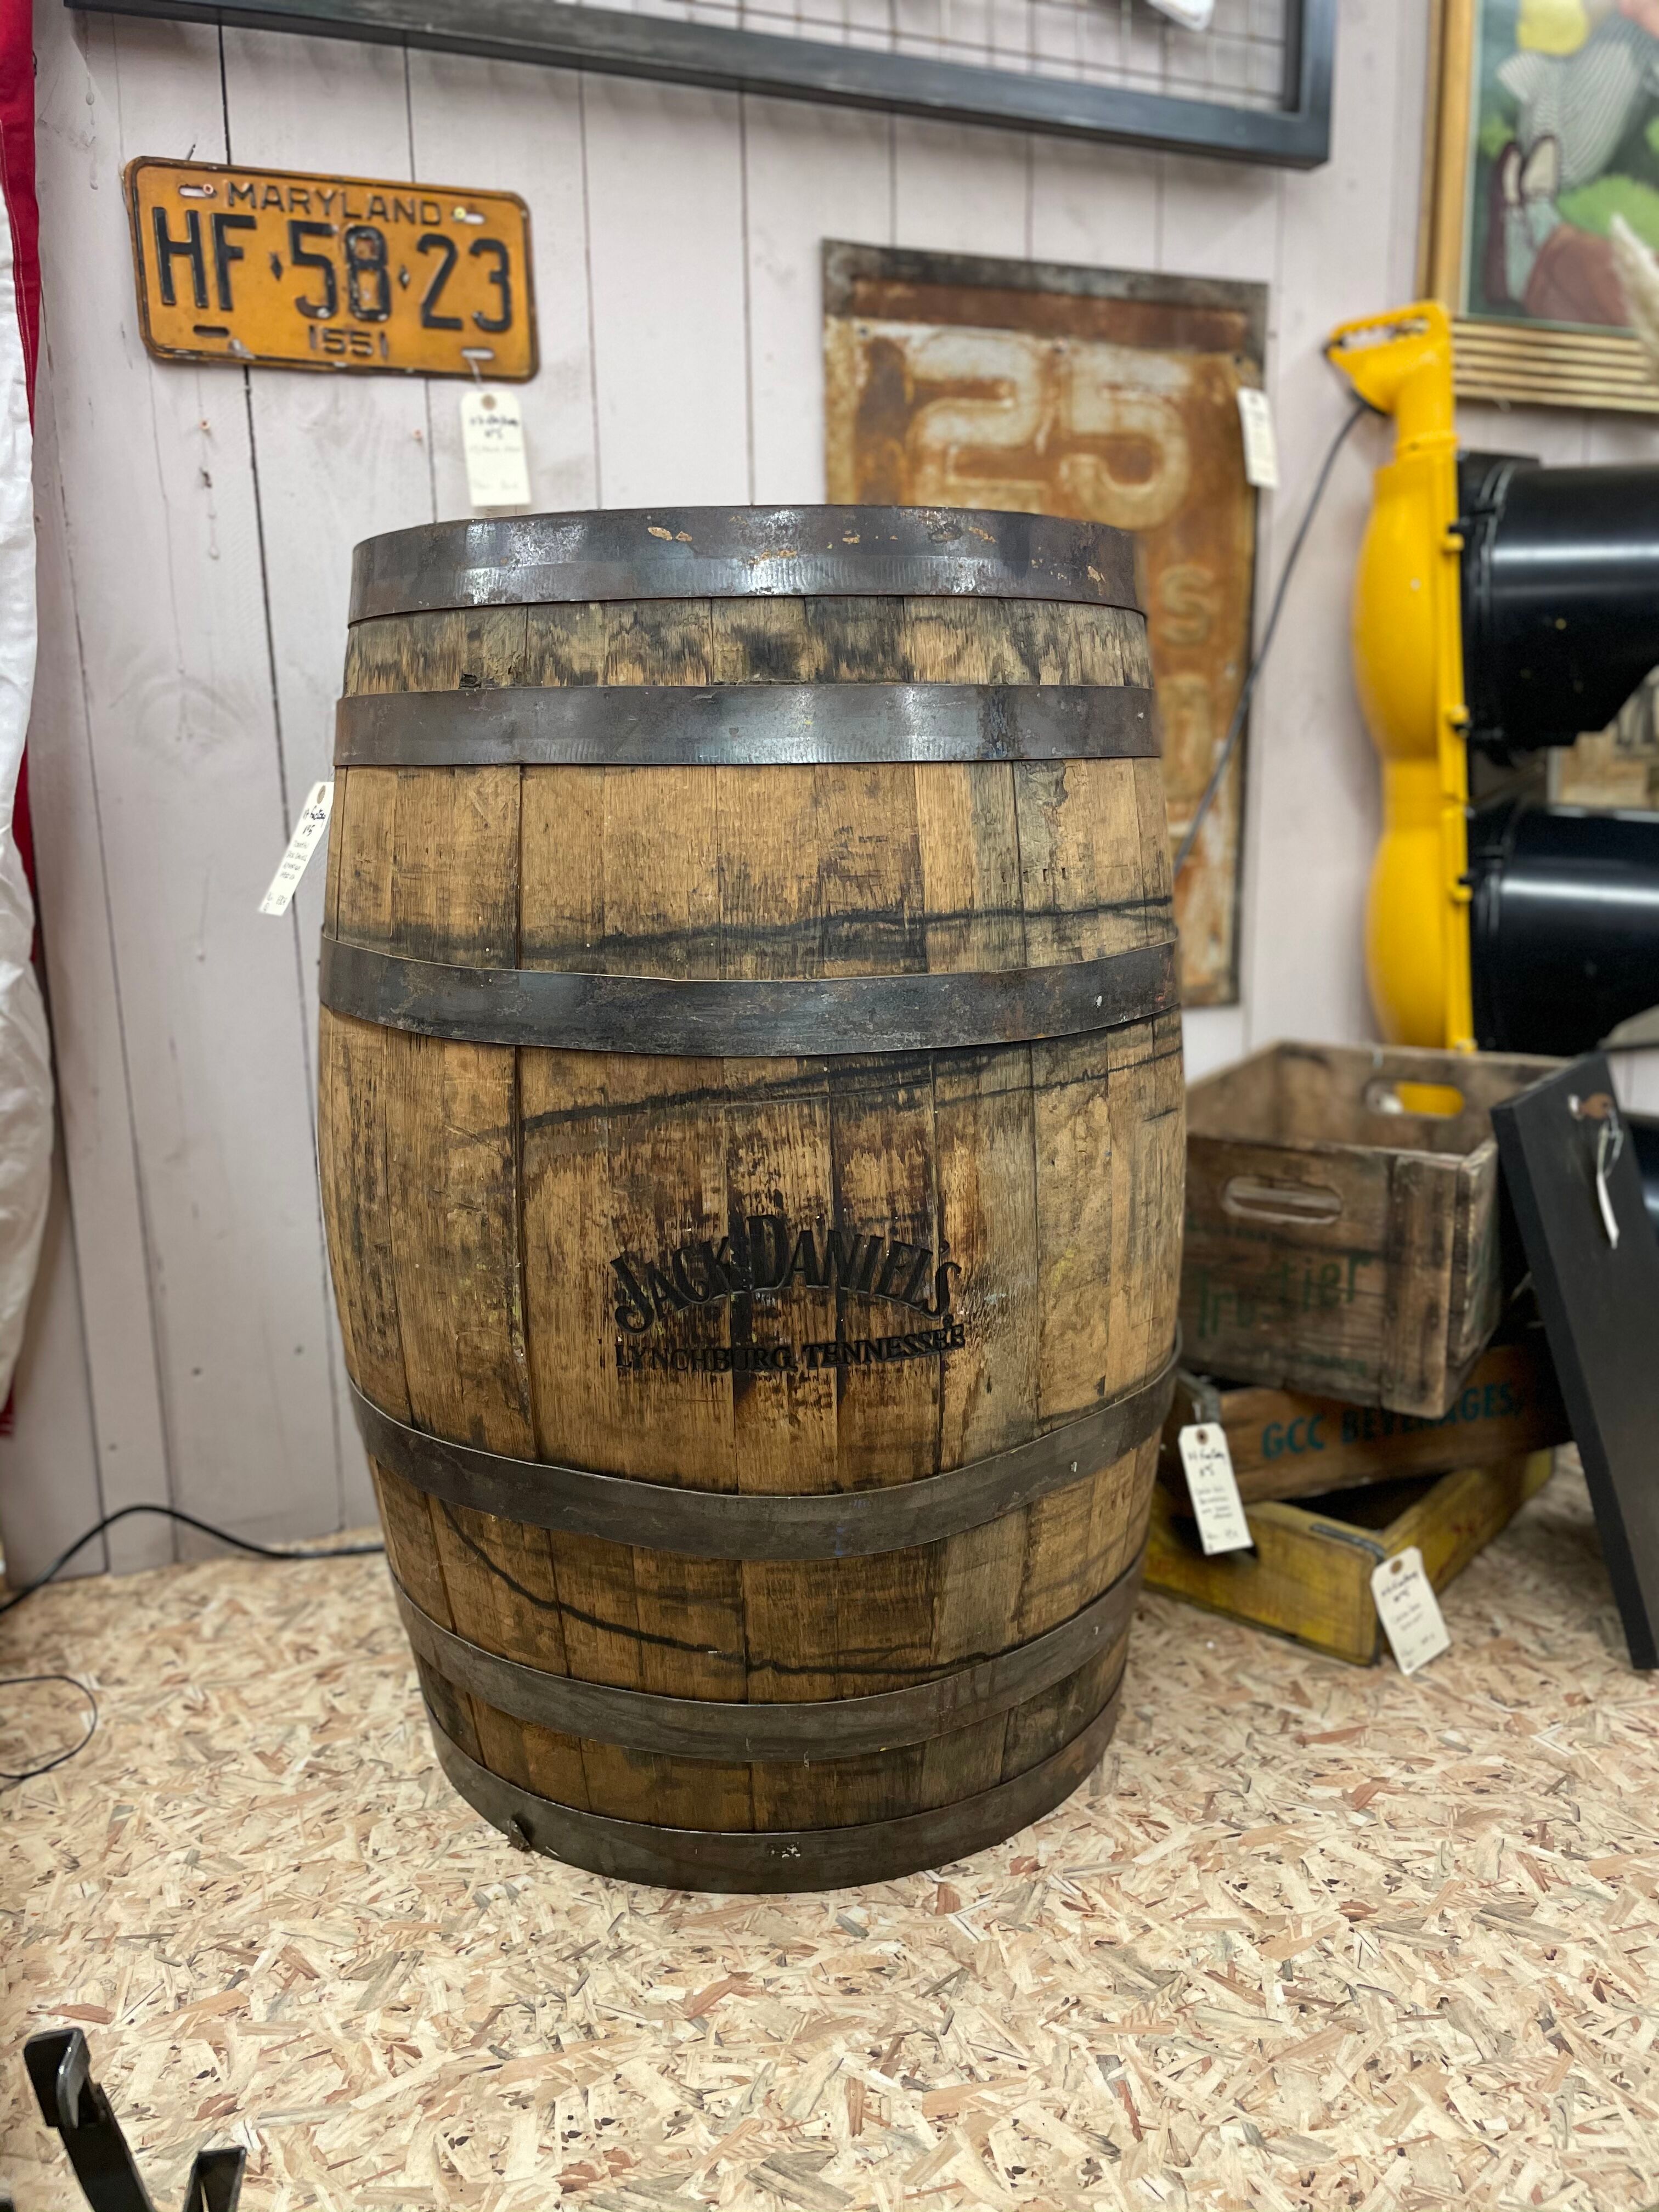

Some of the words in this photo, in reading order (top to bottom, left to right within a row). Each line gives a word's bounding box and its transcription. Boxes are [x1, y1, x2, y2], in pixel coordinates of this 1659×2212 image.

[227, 181, 442, 226] MARYLAND
[905, 331, 1190, 531] 25
[610, 1237, 751, 1334] JACK
[746, 1214, 961, 1320] DANIEL'S
[803, 1323, 966, 1369] TENNESSEE
[1261, 1413, 1325, 1460] GCC
